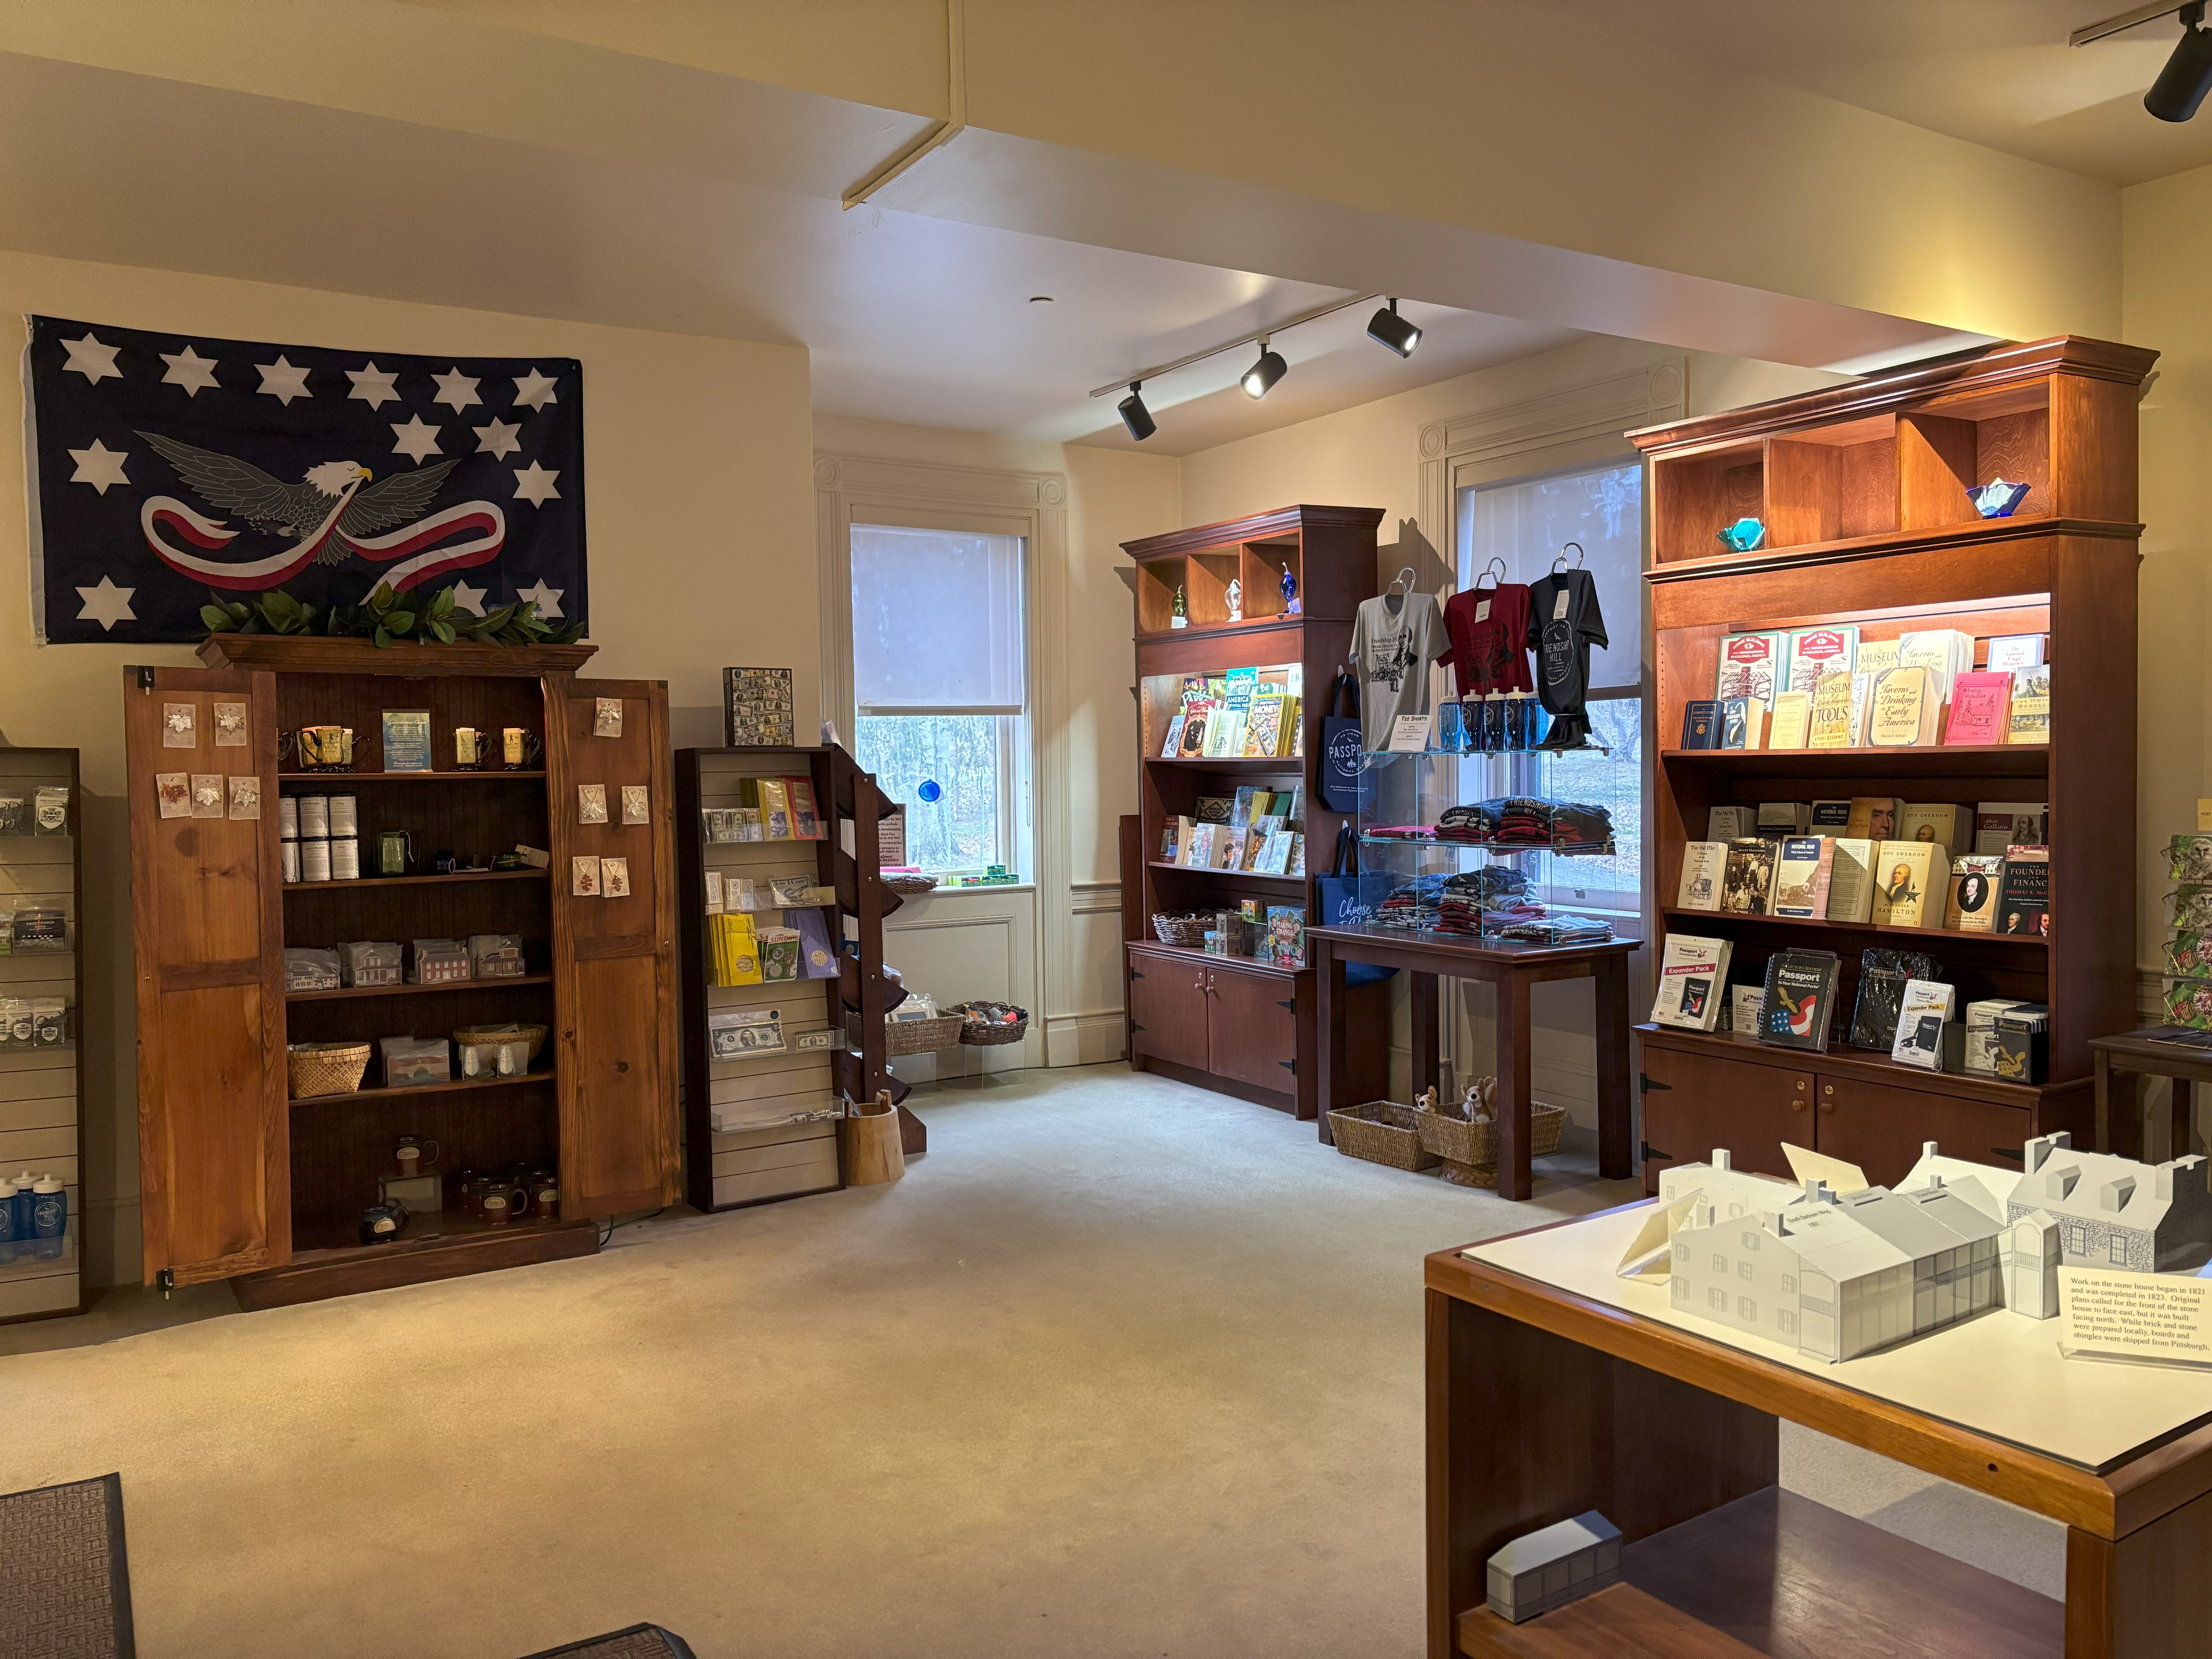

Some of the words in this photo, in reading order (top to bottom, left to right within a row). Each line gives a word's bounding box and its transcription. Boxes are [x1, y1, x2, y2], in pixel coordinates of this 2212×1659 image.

[1544, 640, 1570, 654] FRIENDSHP
[1746, 637, 1765, 648] BUILDING
[1550, 652, 1562, 662] HILL
[1906, 649, 1934, 659] Taverns
[1819, 682, 1850, 696] MUSEUM
[1879, 684, 1910, 695] Taverns
[1881, 694, 1917, 706] Drinking
[1254, 704, 1278, 714] MONEY
[1817, 706, 1848, 722] TOOLS
[1885, 706, 1910, 718] Early
[1878, 717, 1915, 727] America
[1329, 744, 1362, 759] PASSPO
[1336, 760, 1355, 773] NATIONAL
[1510, 798, 1548, 810] FRIENDSHIP
[1339, 896, 1372, 918] Choose
[1277, 921, 1293, 929] MAKING
[1276, 928, 1295, 936] CHANGE
[771, 934, 799, 943] SUNDIAL
[1778, 969, 1820, 982] Passport
[1869, 967, 1898, 977] Passport
[2157, 1285, 2177, 1293] began
[2171, 1295, 2200, 1304] Original
[2073, 1314, 2094, 1322] facing
[2124, 1327, 2149, 1336] locally,
[2074, 1332, 2102, 1340] shingles
[2123, 1336, 2150, 1345] shipped
[2171, 1341, 2210, 1351] Pittsburgh.
